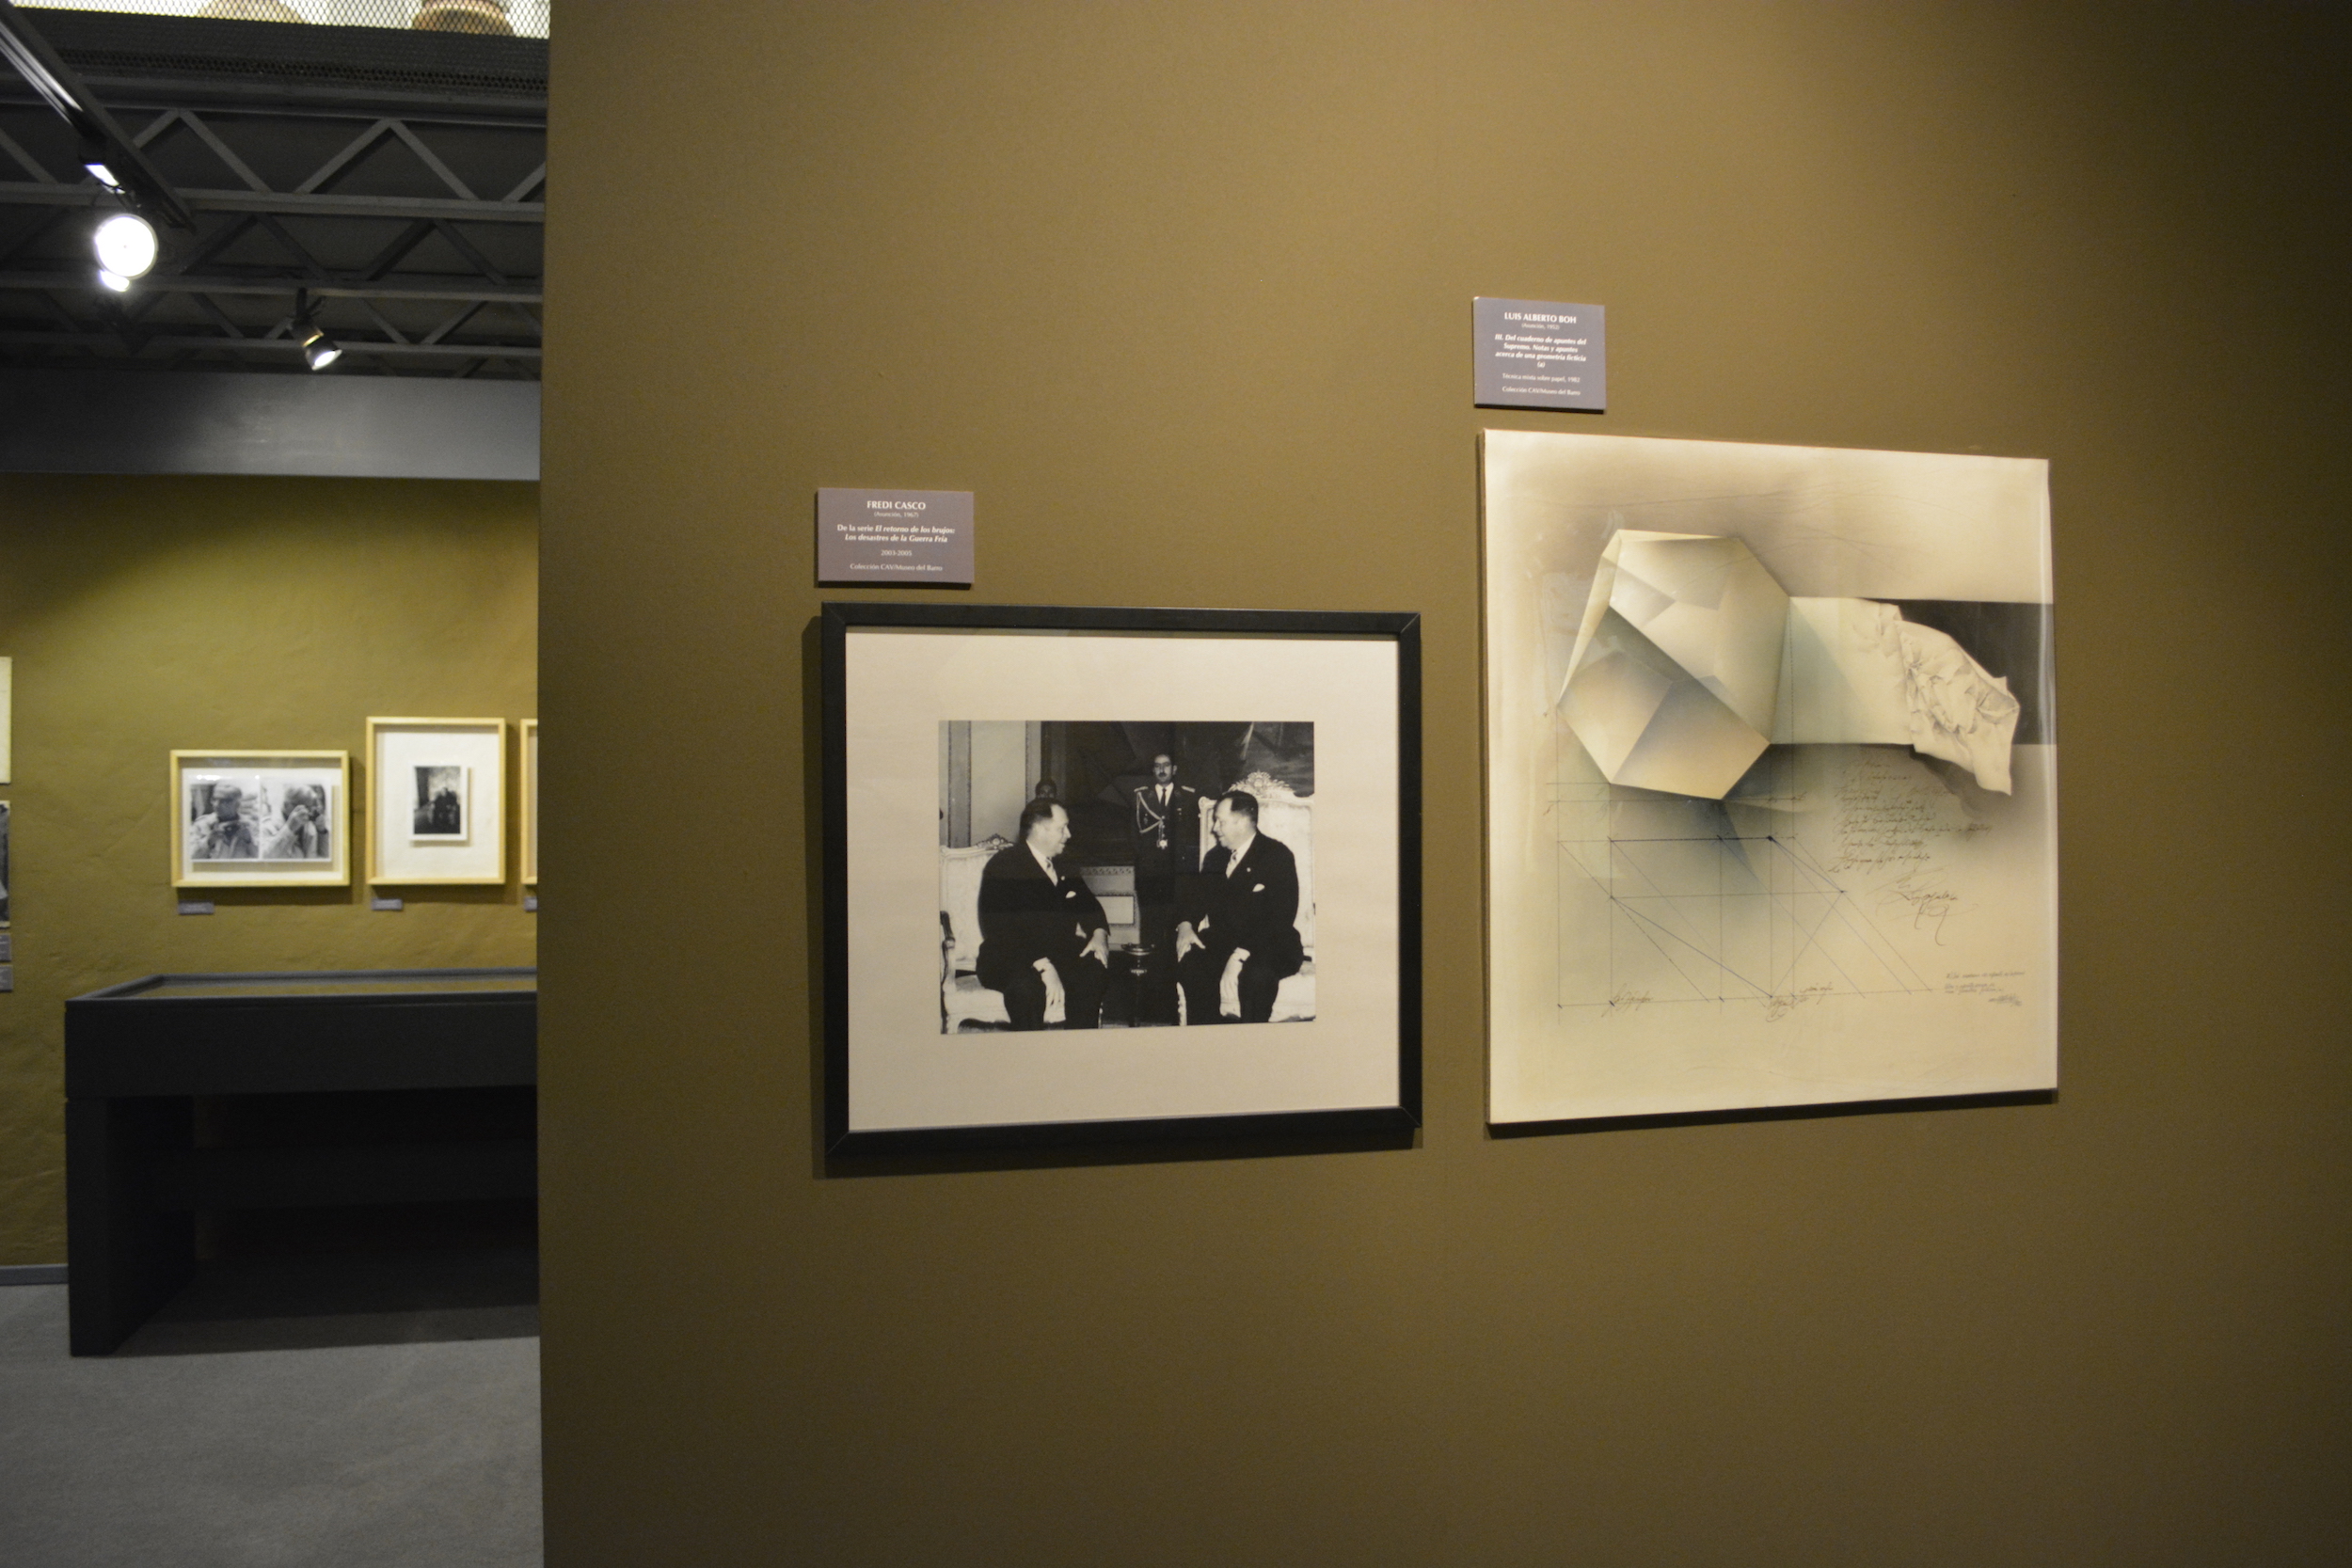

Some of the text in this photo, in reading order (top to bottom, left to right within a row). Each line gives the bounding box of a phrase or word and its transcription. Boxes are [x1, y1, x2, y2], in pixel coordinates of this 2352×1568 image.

[1523, 314, 1557, 323] ALBERTO
[867, 500, 926, 510] FREDI CASCO
